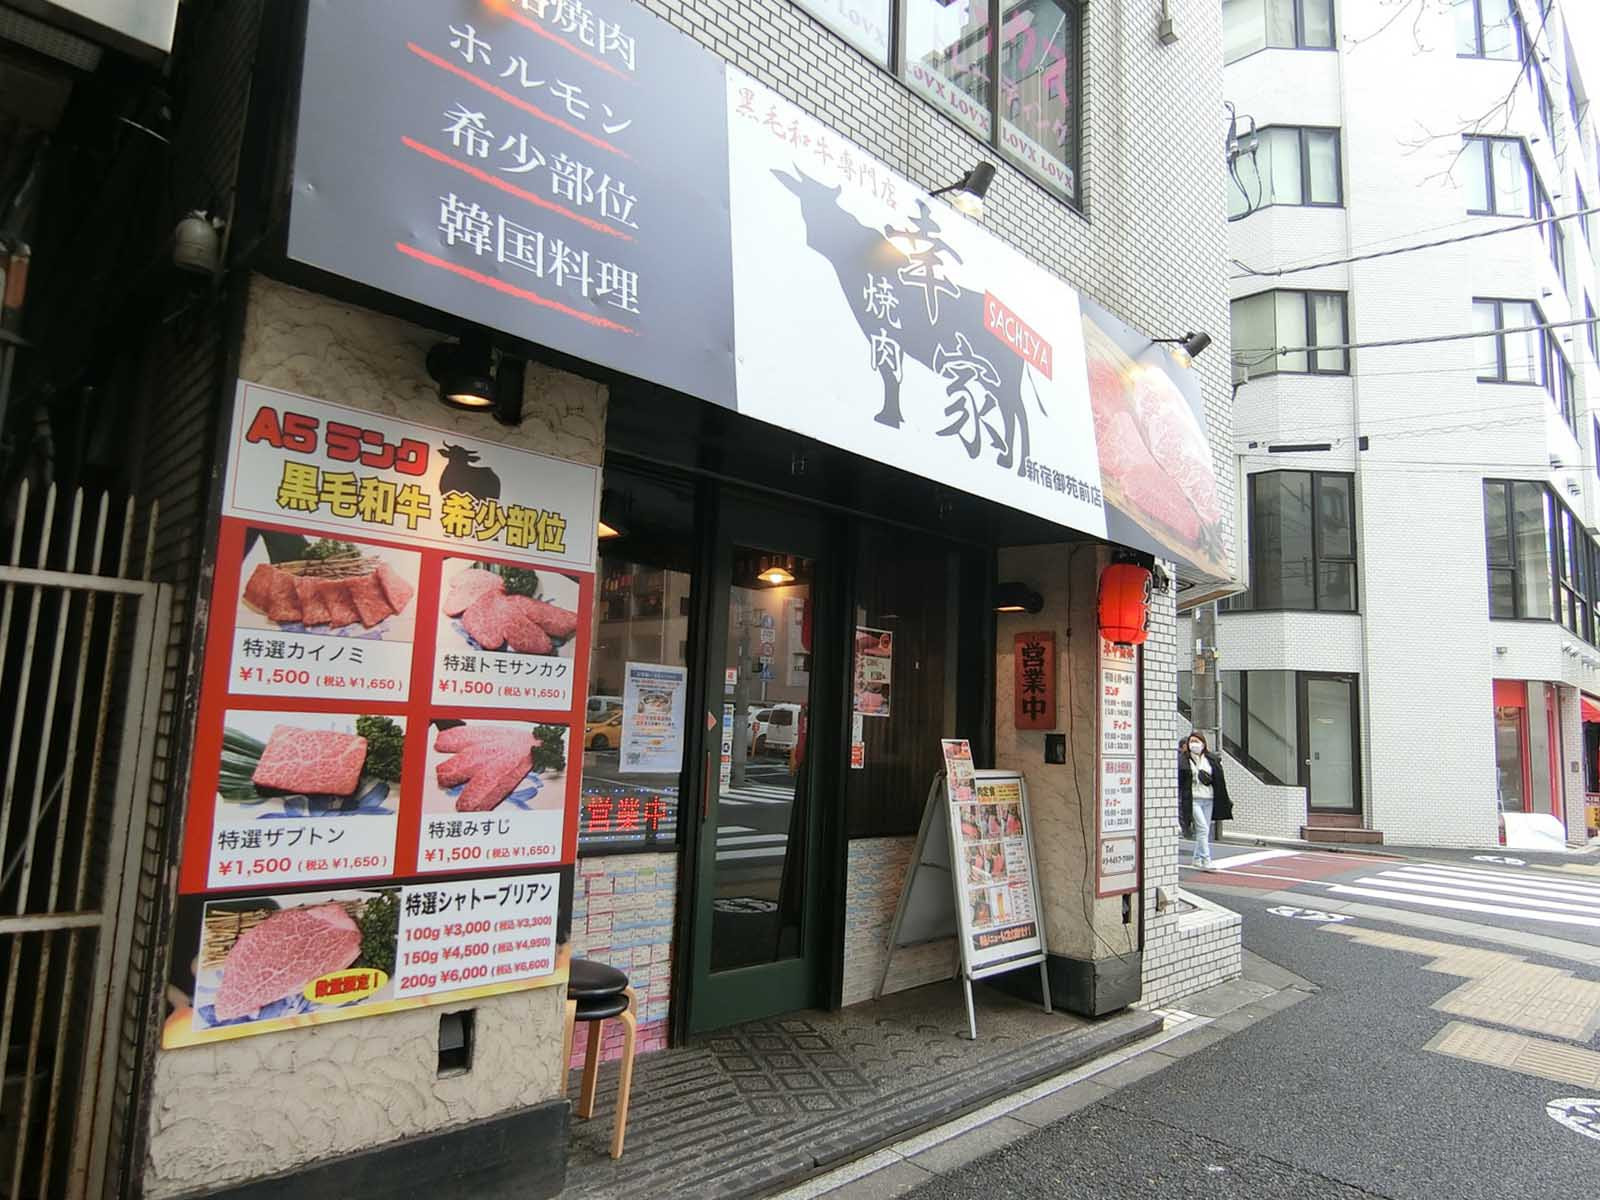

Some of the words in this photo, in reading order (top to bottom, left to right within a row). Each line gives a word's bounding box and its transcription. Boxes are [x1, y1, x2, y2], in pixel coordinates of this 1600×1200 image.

[447, 23, 633, 135] ホルモン
[949, 91, 990, 133] LOVX
[441, 102, 640, 231] 希少部位
[1002, 127, 1037, 163] LOVX
[1040, 156, 1074, 190] LOVX
[438, 192, 641, 315] 韓国料理
[862, 272, 903, 384] 焼肉
[988, 302, 1050, 368] SACHIYA
[324, 420, 431, 478] ランク
[1026, 461, 1103, 508] 新宿御苑前店
[276, 460, 433, 530] 黒毛和牛
[439, 490, 567, 554] 希少部位
[242, 637, 365, 664] 特選カイノミ
[443, 653, 568, 678] 特選トモサンカク
[239, 666, 311, 686] ¥1,500
[438, 679, 494, 696] ¥1,500
[1021, 641, 1046, 721] 営業中
[428, 819, 511, 839] 特選みすじ
[587, 794, 668, 833] 営業中
[217, 826, 346, 850] 特選ザブトン
[424, 846, 482, 863] ¥1,500
[218, 857, 292, 877] ¥1,500
[405, 882, 553, 917] 特選シャトーブリアン
[404, 928, 441, 942] 100g
[444, 918, 491, 937] ¥3,000
[402, 952, 439, 966] 150g
[442, 942, 490, 961] ¥4,500
[400, 974, 437, 988] 200g
[440, 965, 488, 983] ¥6,000
